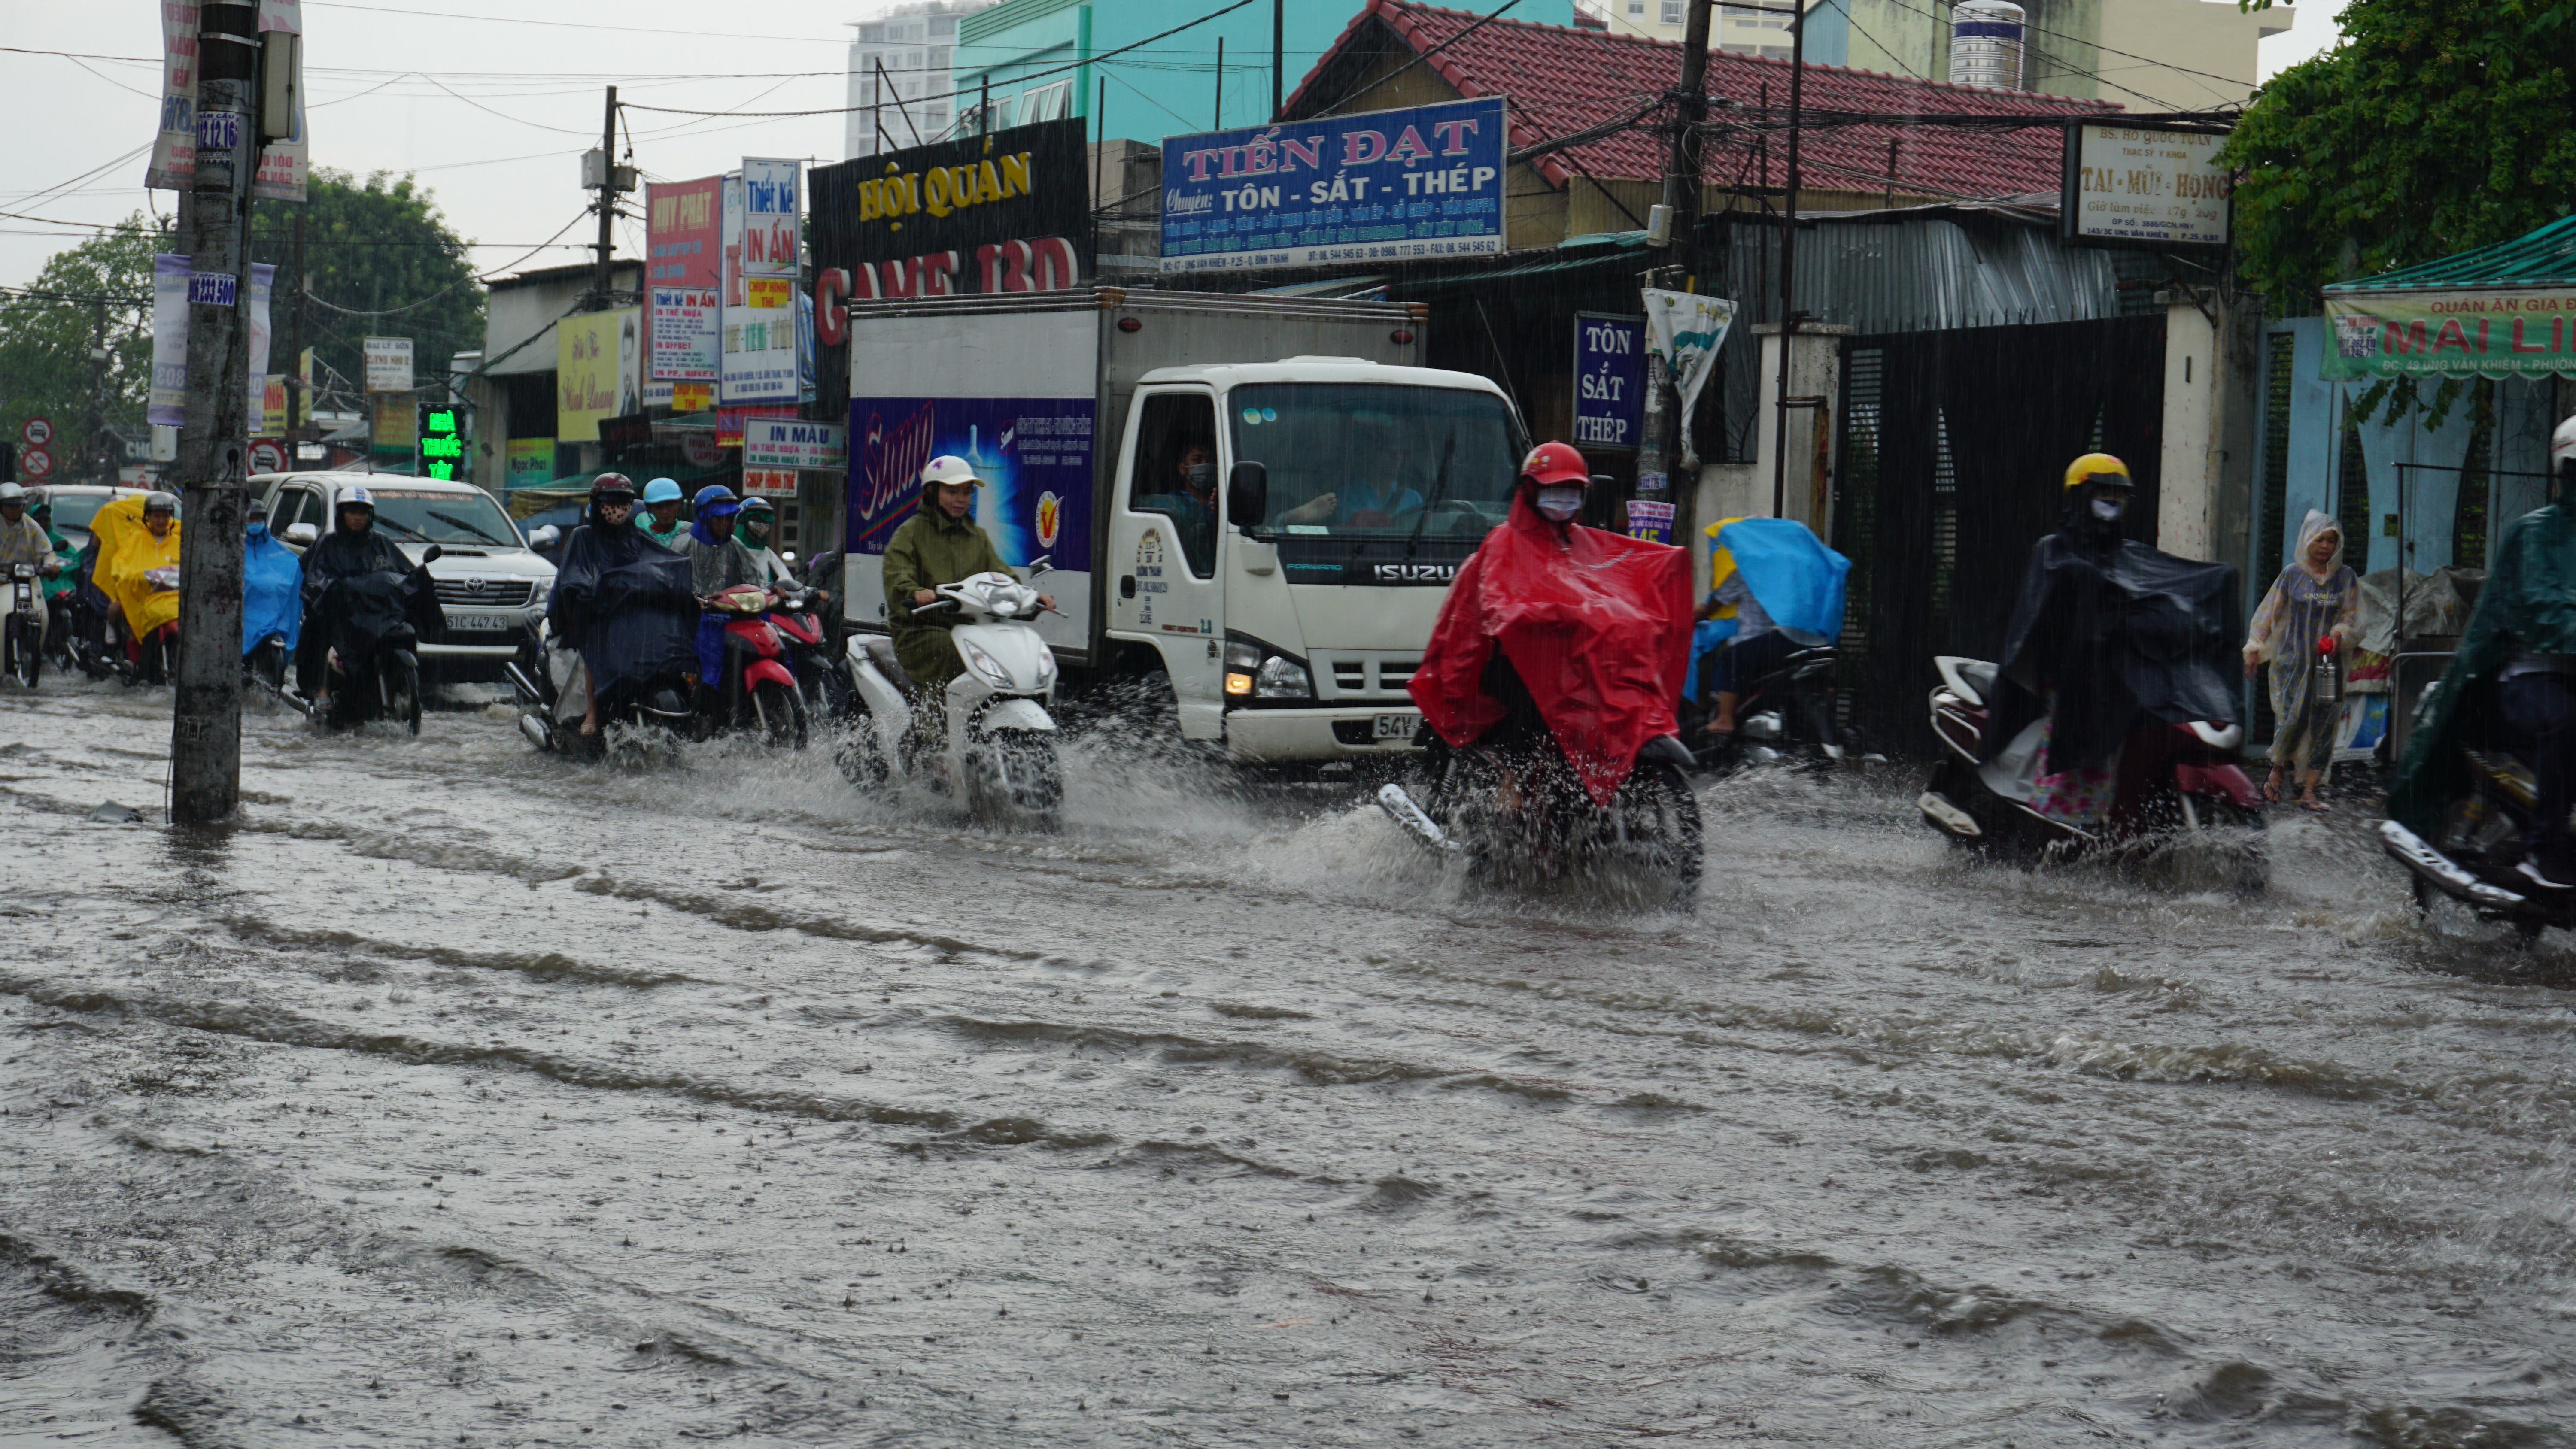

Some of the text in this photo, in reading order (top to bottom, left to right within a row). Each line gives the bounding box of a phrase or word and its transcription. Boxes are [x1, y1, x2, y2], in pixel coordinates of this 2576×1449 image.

[2099, 128, 2118, 139] BS.
[1182, 119, 1479, 182] TIẾN ĐẠT
[747, 170, 793, 214] Thiết Kế
[858, 134, 1032, 232] HỘI QUÁN
[1166, 162, 1496, 214] Chuyên: TÔN SẮT THÉP
[2081, 167, 2114, 192] TAI
[2176, 173, 2230, 205] HỌNG
[653, 186, 712, 233] HUY PHÁT
[1371, 203, 1385, 220] ÉP
[2112, 218, 2123, 227] GP
[747, 217, 793, 263] IN ẤN
[1330, 249, 1342, 260] 544
[1342, 248, 1354, 258] 545
[1355, 247, 1364, 258] 63
[1399, 245, 1411, 256] 777
[1413, 244, 1425, 255] 553
[1458, 242, 1470, 252] 544
[1472, 241, 1485, 252] 545
[1486, 240, 1495, 252] 62
[655, 289, 672, 306] Thiết
[686, 294, 697, 307] IN
[699, 290, 716, 308] ẤN
[2431, 297, 2559, 314] QUÁN ĂN GIA
[1586, 321, 1632, 355] TÔN
[2383, 315, 2489, 355] MAI
[2406, 360, 2419, 370] 49
[1581, 361, 1625, 401] SẮT
[429, 409, 456, 432] NHÀ
[1577, 410, 1627, 443] THÉP
[421, 432, 462, 457] THUỐC
[770, 424, 829, 444] IN MÀU
[750, 443, 757, 451] IN
[428, 459, 454, 481] TÂY
[1374, 564, 1455, 581] ISUZU
[446, 615, 507, 629] 51C-447.43
